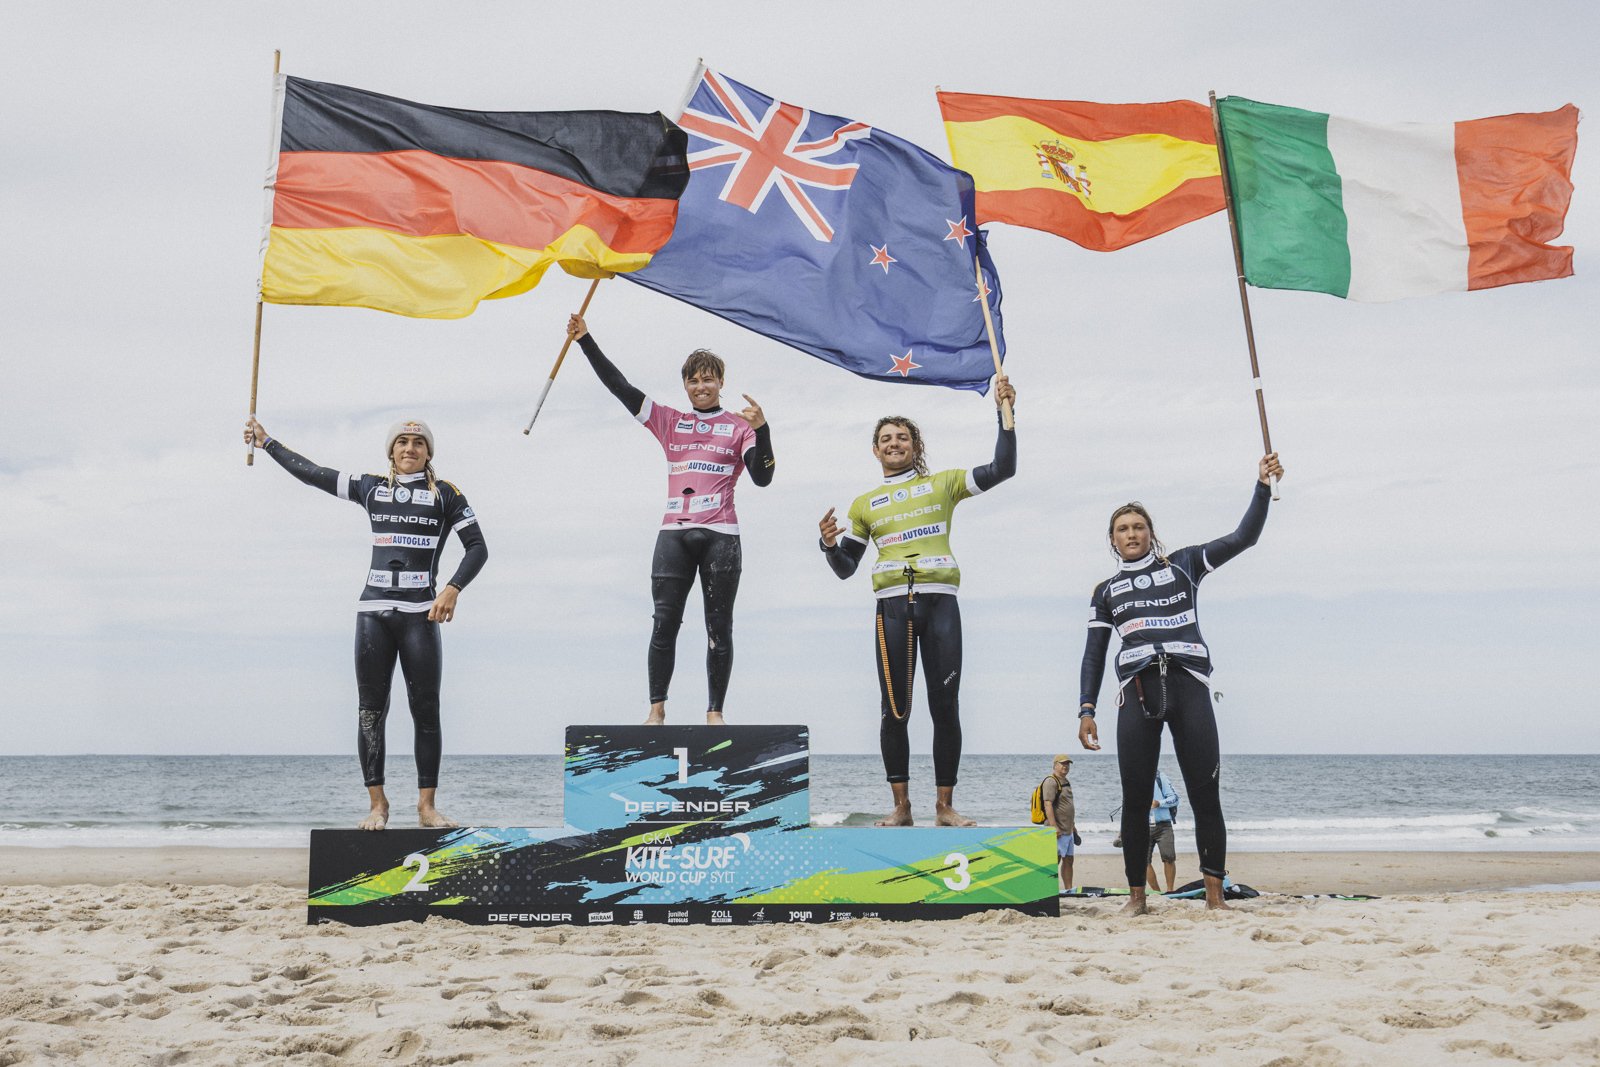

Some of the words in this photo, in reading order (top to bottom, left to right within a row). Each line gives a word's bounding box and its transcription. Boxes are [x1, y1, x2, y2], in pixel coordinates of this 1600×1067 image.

[371, 512, 439, 526] DEFENDER
[870, 503, 942, 531] DEFENDER
[1111, 591, 1188, 617] DEFENDER
[673, 747, 688, 784] 1
[624, 801, 751, 813] DEFENDER
[642, 832, 673, 845] GKA
[624, 845, 737, 870] KITE-SURF
[402, 853, 430, 892] 2
[624, 871, 676, 883] WORLD
[679, 871, 707, 883] CUP
[710, 871, 736, 883] SYLT
[943, 852, 971, 891] 3
[488, 913, 572, 922] DEFENDER
[711, 910, 733, 918] ZOLL
